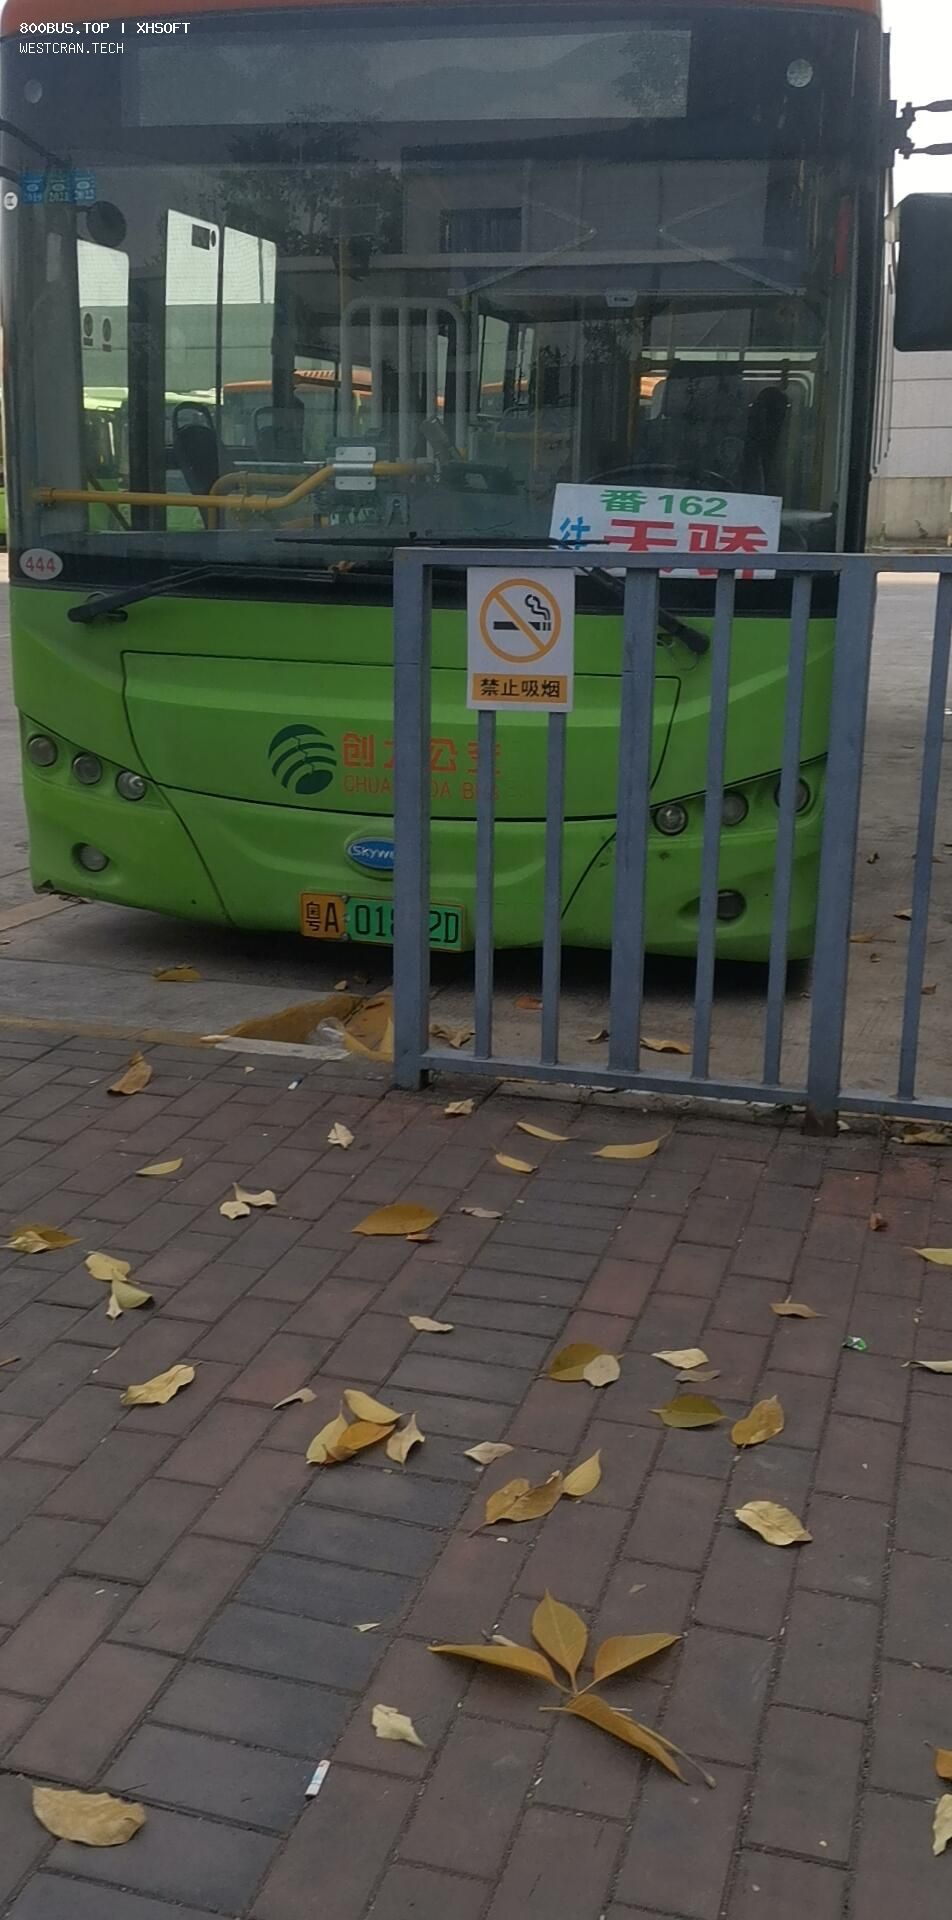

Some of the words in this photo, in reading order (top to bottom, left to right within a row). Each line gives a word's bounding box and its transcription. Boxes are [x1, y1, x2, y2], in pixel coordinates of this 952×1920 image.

[601, 489, 648, 514] 番
[658, 493, 729, 518] 162
[25, 556, 57, 573] 444
[480, 677, 561, 698] 禁止吸烟
[342, 774, 452, 799] CHUADA
[354, 904, 460, 945] 012D
